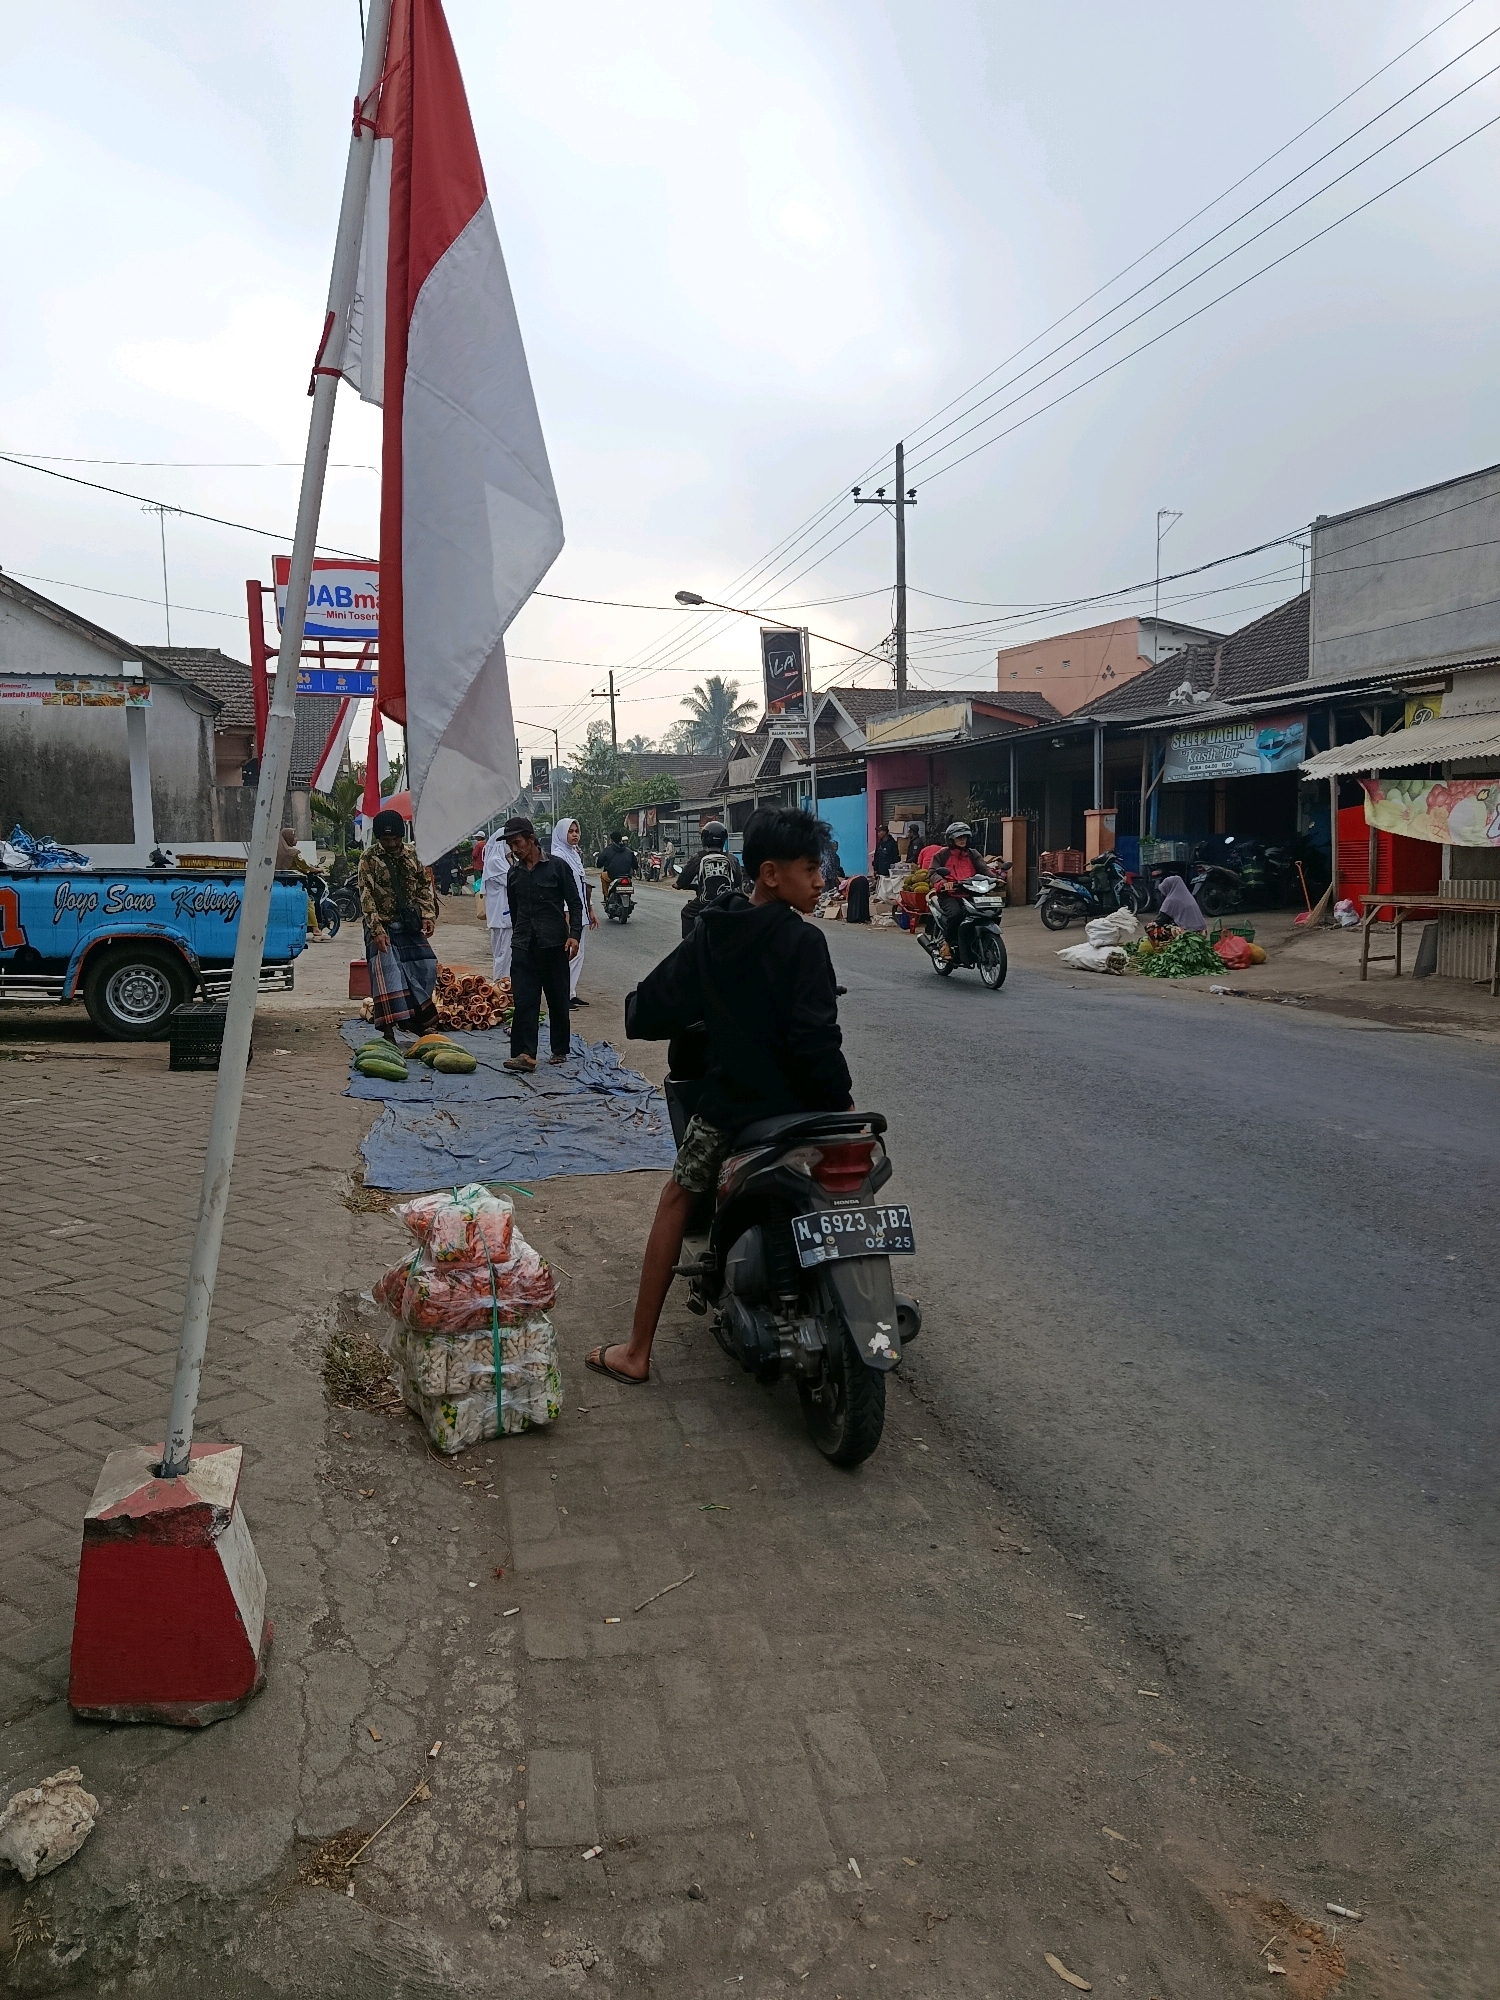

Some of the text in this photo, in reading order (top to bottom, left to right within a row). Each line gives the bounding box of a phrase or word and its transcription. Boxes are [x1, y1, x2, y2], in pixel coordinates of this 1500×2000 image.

[326, 610, 347, 620] Mini
[1173, 722, 1255, 750] SELEP DAGING
[53, 881, 99, 924] Joyo
[103, 884, 156, 913] Sono
[171, 884, 241, 923] Keling
[820, 1213, 867, 1234] 6923
